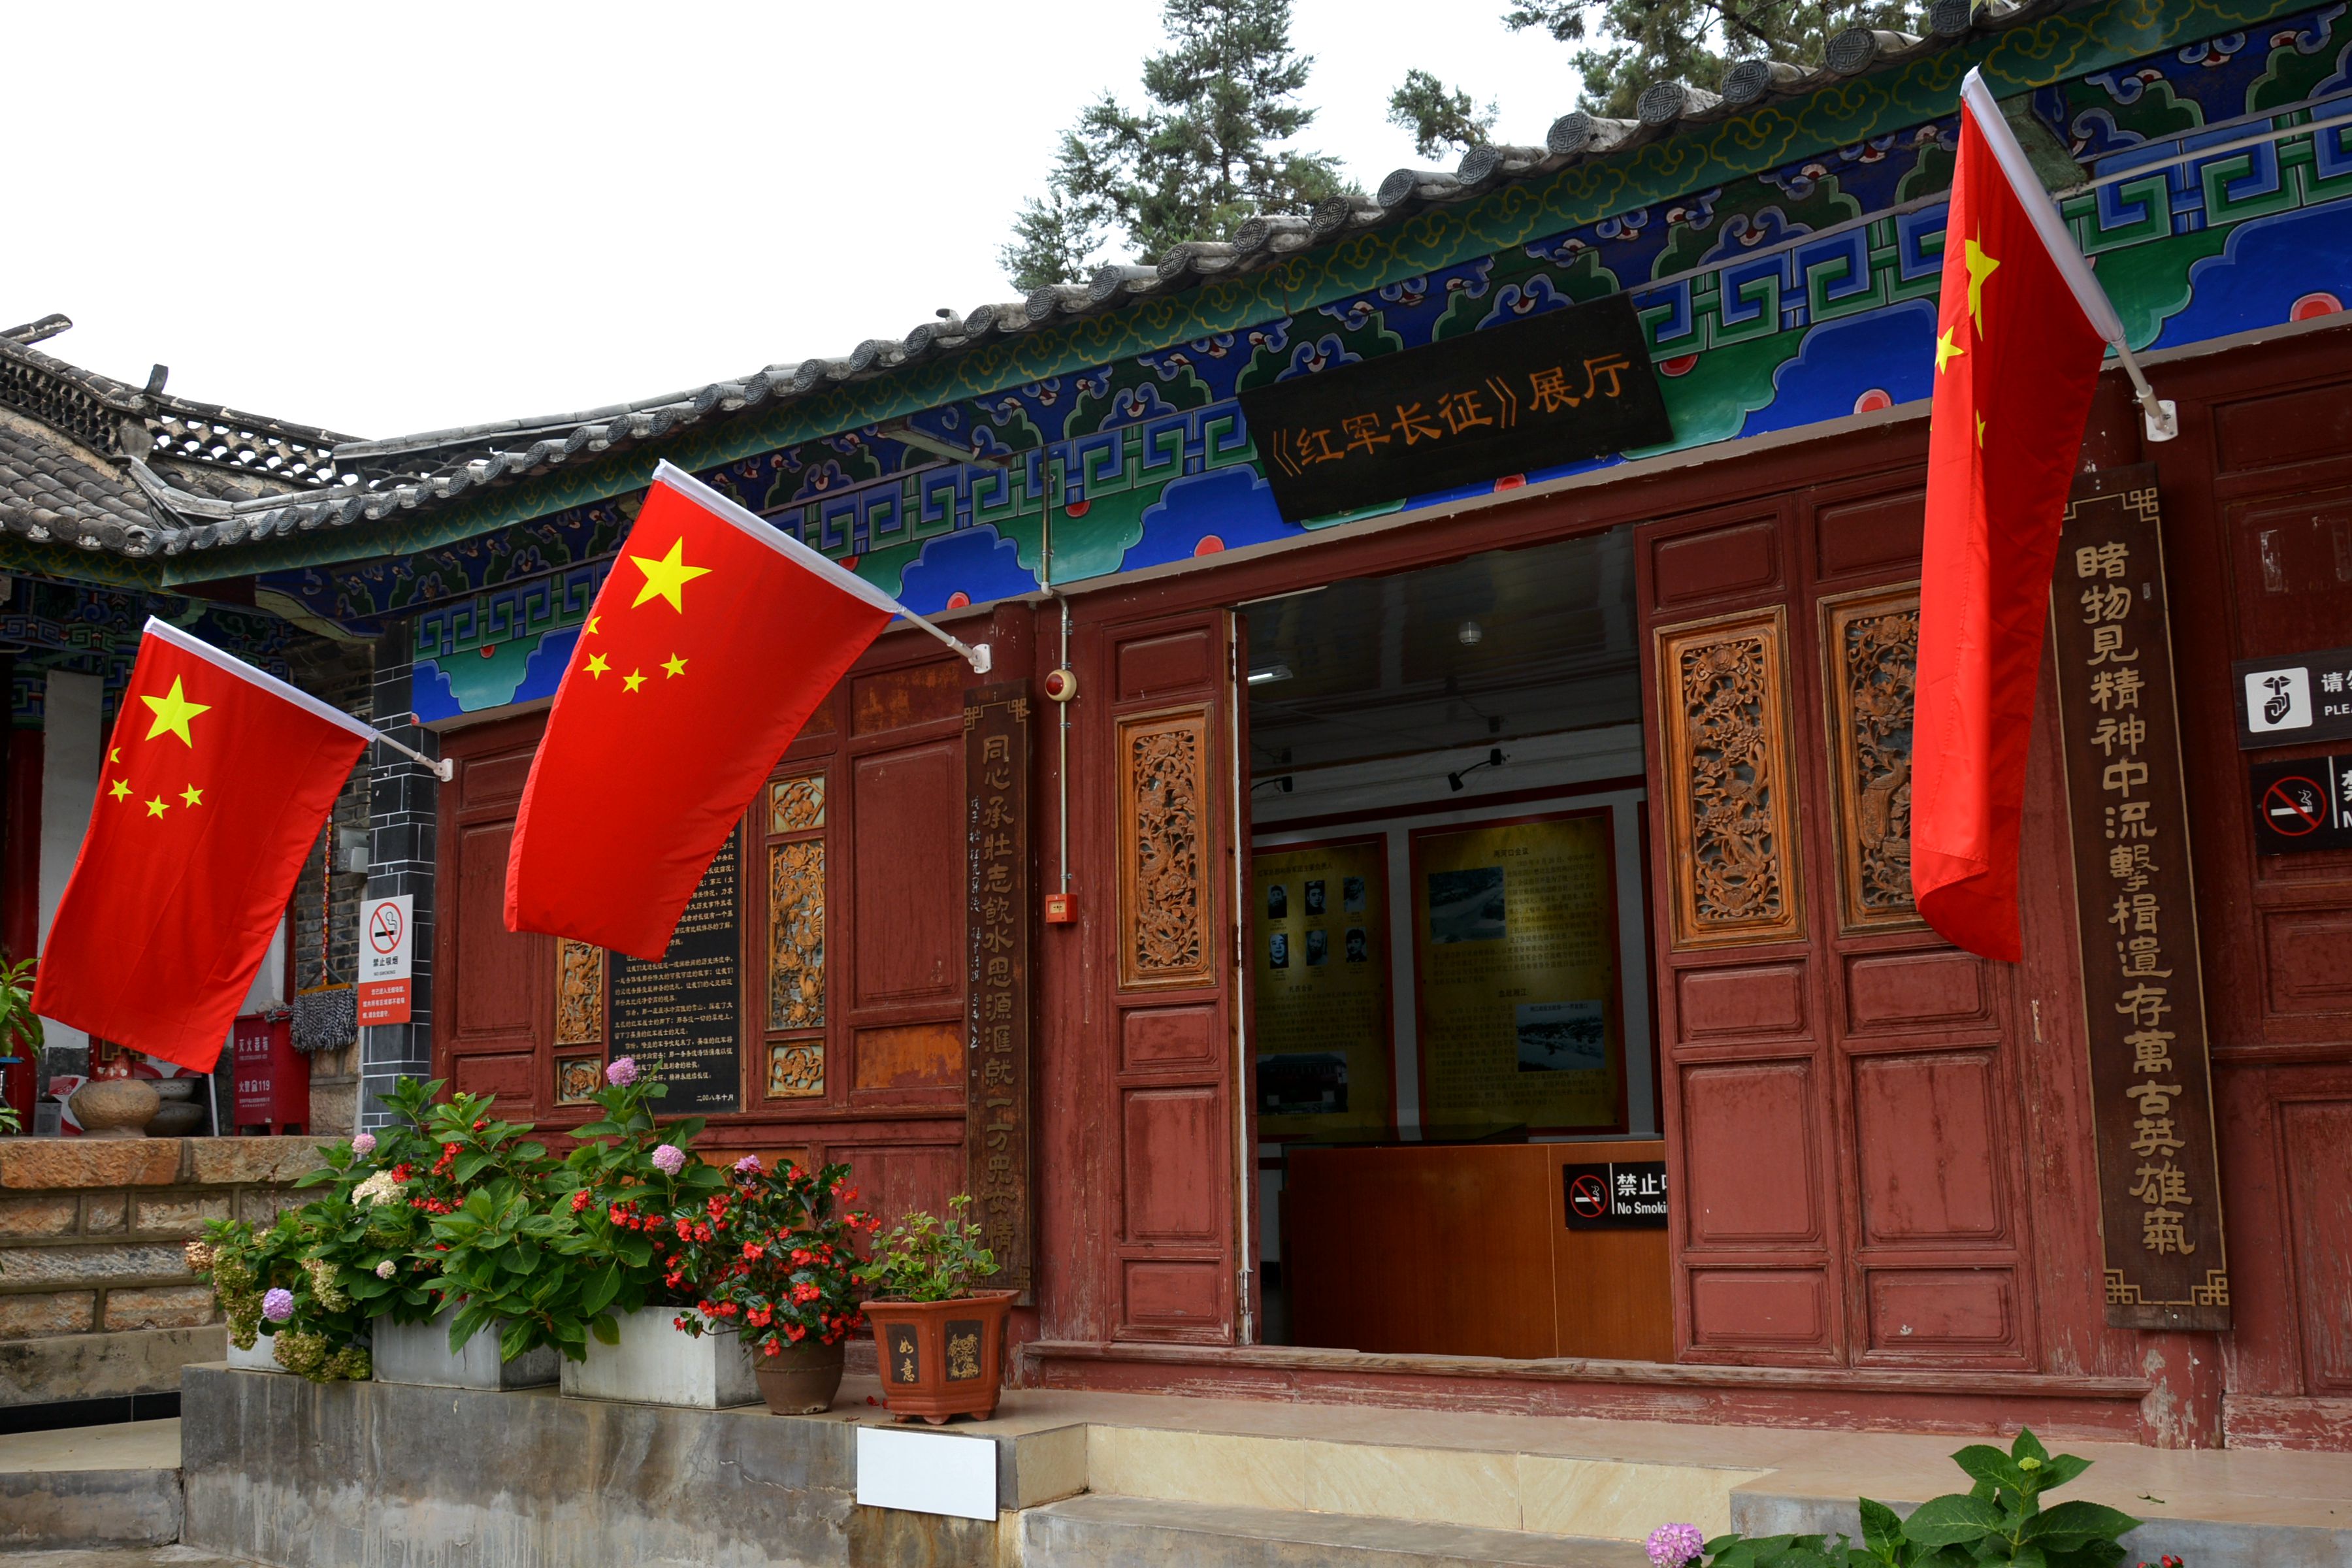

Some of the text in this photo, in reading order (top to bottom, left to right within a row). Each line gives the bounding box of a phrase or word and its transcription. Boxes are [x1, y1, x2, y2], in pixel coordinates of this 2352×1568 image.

[1273, 353, 1630, 477] 《红军长征》展厅
[2321, 670, 2352, 693] 请
[373, 956, 399, 967] 禁止吸烟
[259, 1080, 270, 1091] 119
[1617, 1173, 1667, 1196] 禁止
[1617, 1202, 1631, 1215] No
